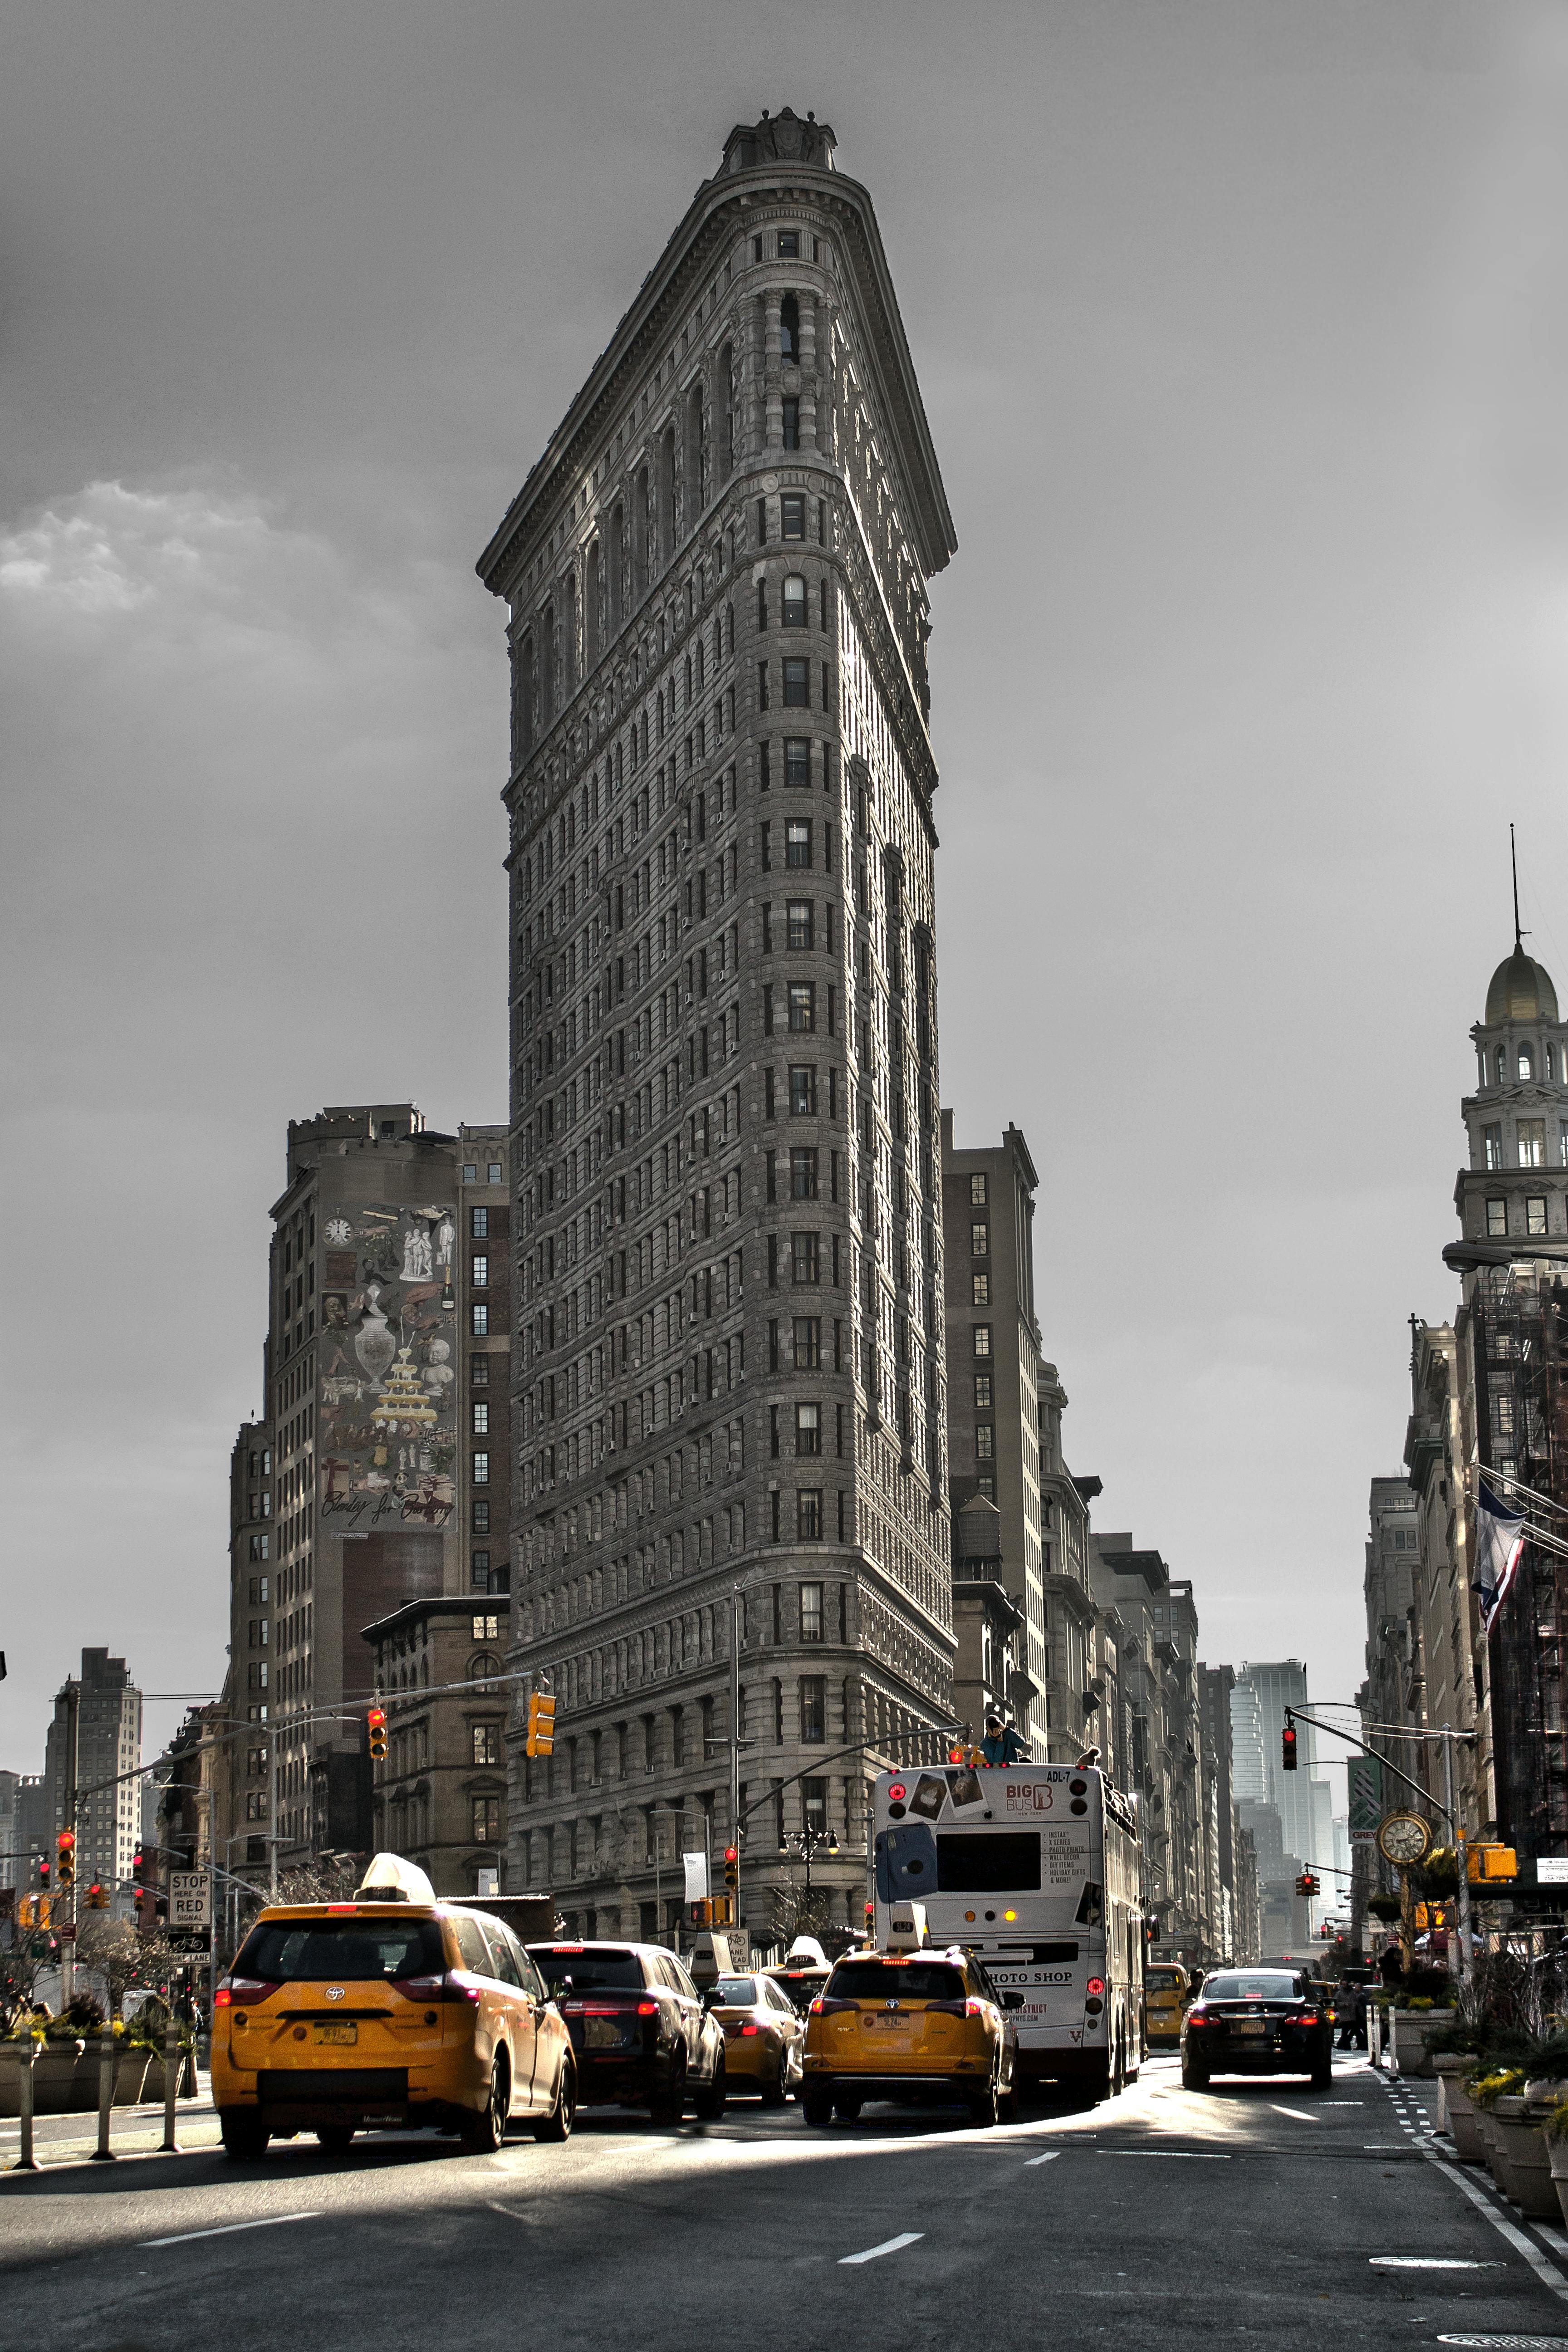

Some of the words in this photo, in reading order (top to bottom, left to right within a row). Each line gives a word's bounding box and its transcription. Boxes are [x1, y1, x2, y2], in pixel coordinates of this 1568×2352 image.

[1006, 1784, 1032, 1798] BIG
[1006, 1798, 1032, 1811] BUS
[172, 1875, 208, 1888] STOP
[176, 1900, 204, 1912] RED
[190, 1953, 209, 1962] LANE
[989, 1973, 1028, 1983] HOTO
[1034, 1972, 1072, 1982] SHOP
[1016, 2004, 1047, 2014] DISTRICT
